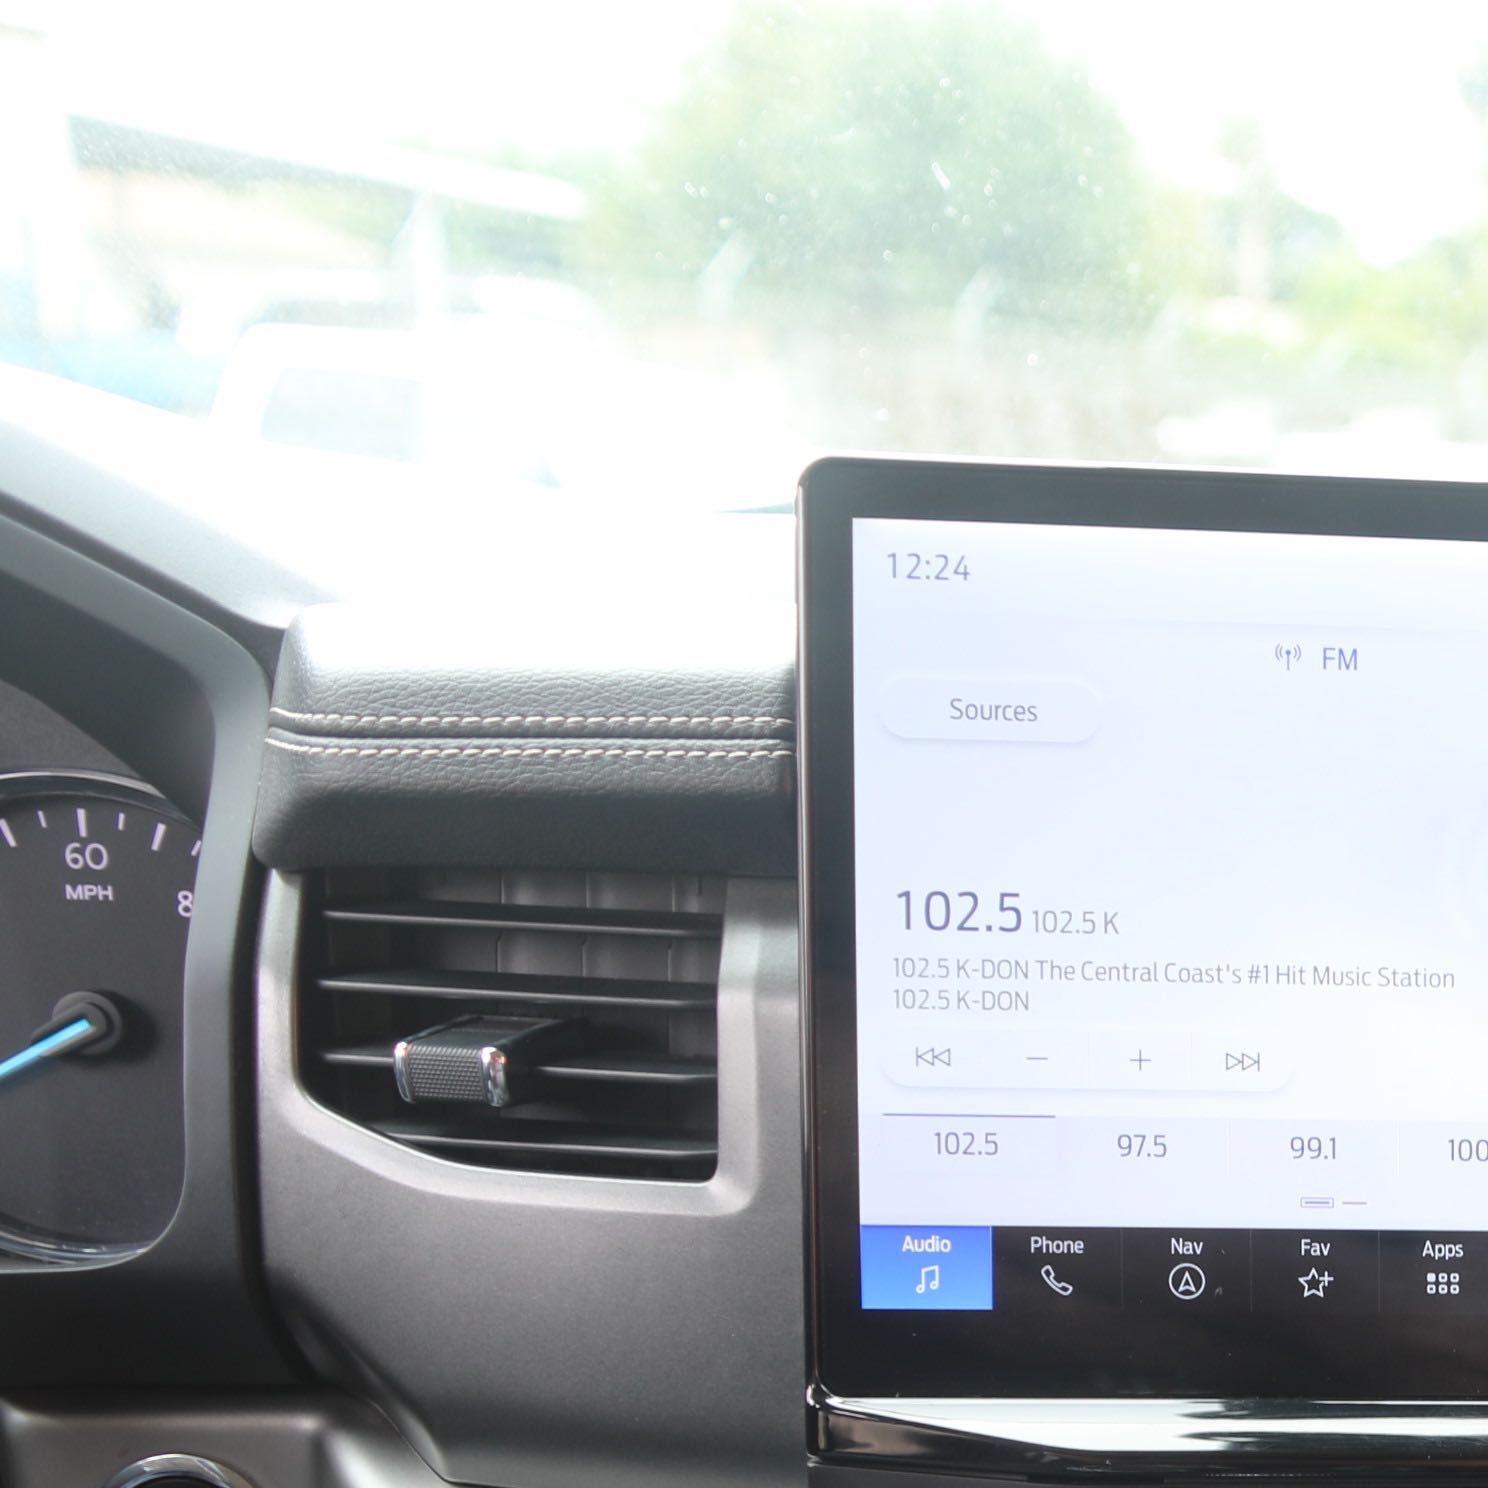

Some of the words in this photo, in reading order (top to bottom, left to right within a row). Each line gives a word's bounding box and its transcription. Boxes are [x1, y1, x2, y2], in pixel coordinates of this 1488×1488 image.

[885, 551, 972, 582] 12:24
[1321, 647, 1359, 672] FM
[949, 697, 1038, 723] Sources
[64, 843, 109, 872] 60
[64, 883, 114, 901] MPH
[896, 889, 1024, 933] 102.5
[1031, 909, 1097, 935] 102.5
[1103, 911, 1120, 935] K
[892, 956, 951, 980] 102.5
[956, 957, 1030, 982] K-DON
[1034, 959, 1077, 983] The
[1080, 960, 1160, 985] Central
[1163, 961, 1242, 985] Coast's
[1247, 963, 1272, 986] #1
[1275, 964, 1307, 988] Hit
[1311, 966, 1372, 989] Music
[1377, 966, 1456, 990] Station
[892, 987, 951, 1011] 102.5
[956, 988, 1030, 1012] K-DON
[933, 1130, 999, 1156] 102.5
[1116, 1133, 1168, 1159] 97.5
[1289, 1136, 1339, 1161] 99.1
[901, 1235, 952, 1255] Audio
[1029, 1236, 1085, 1256] Phone
[1170, 1238, 1204, 1256] Nav
[1300, 1238, 1331, 1257] Fav
[1421, 1239, 1464, 1262] Apps
